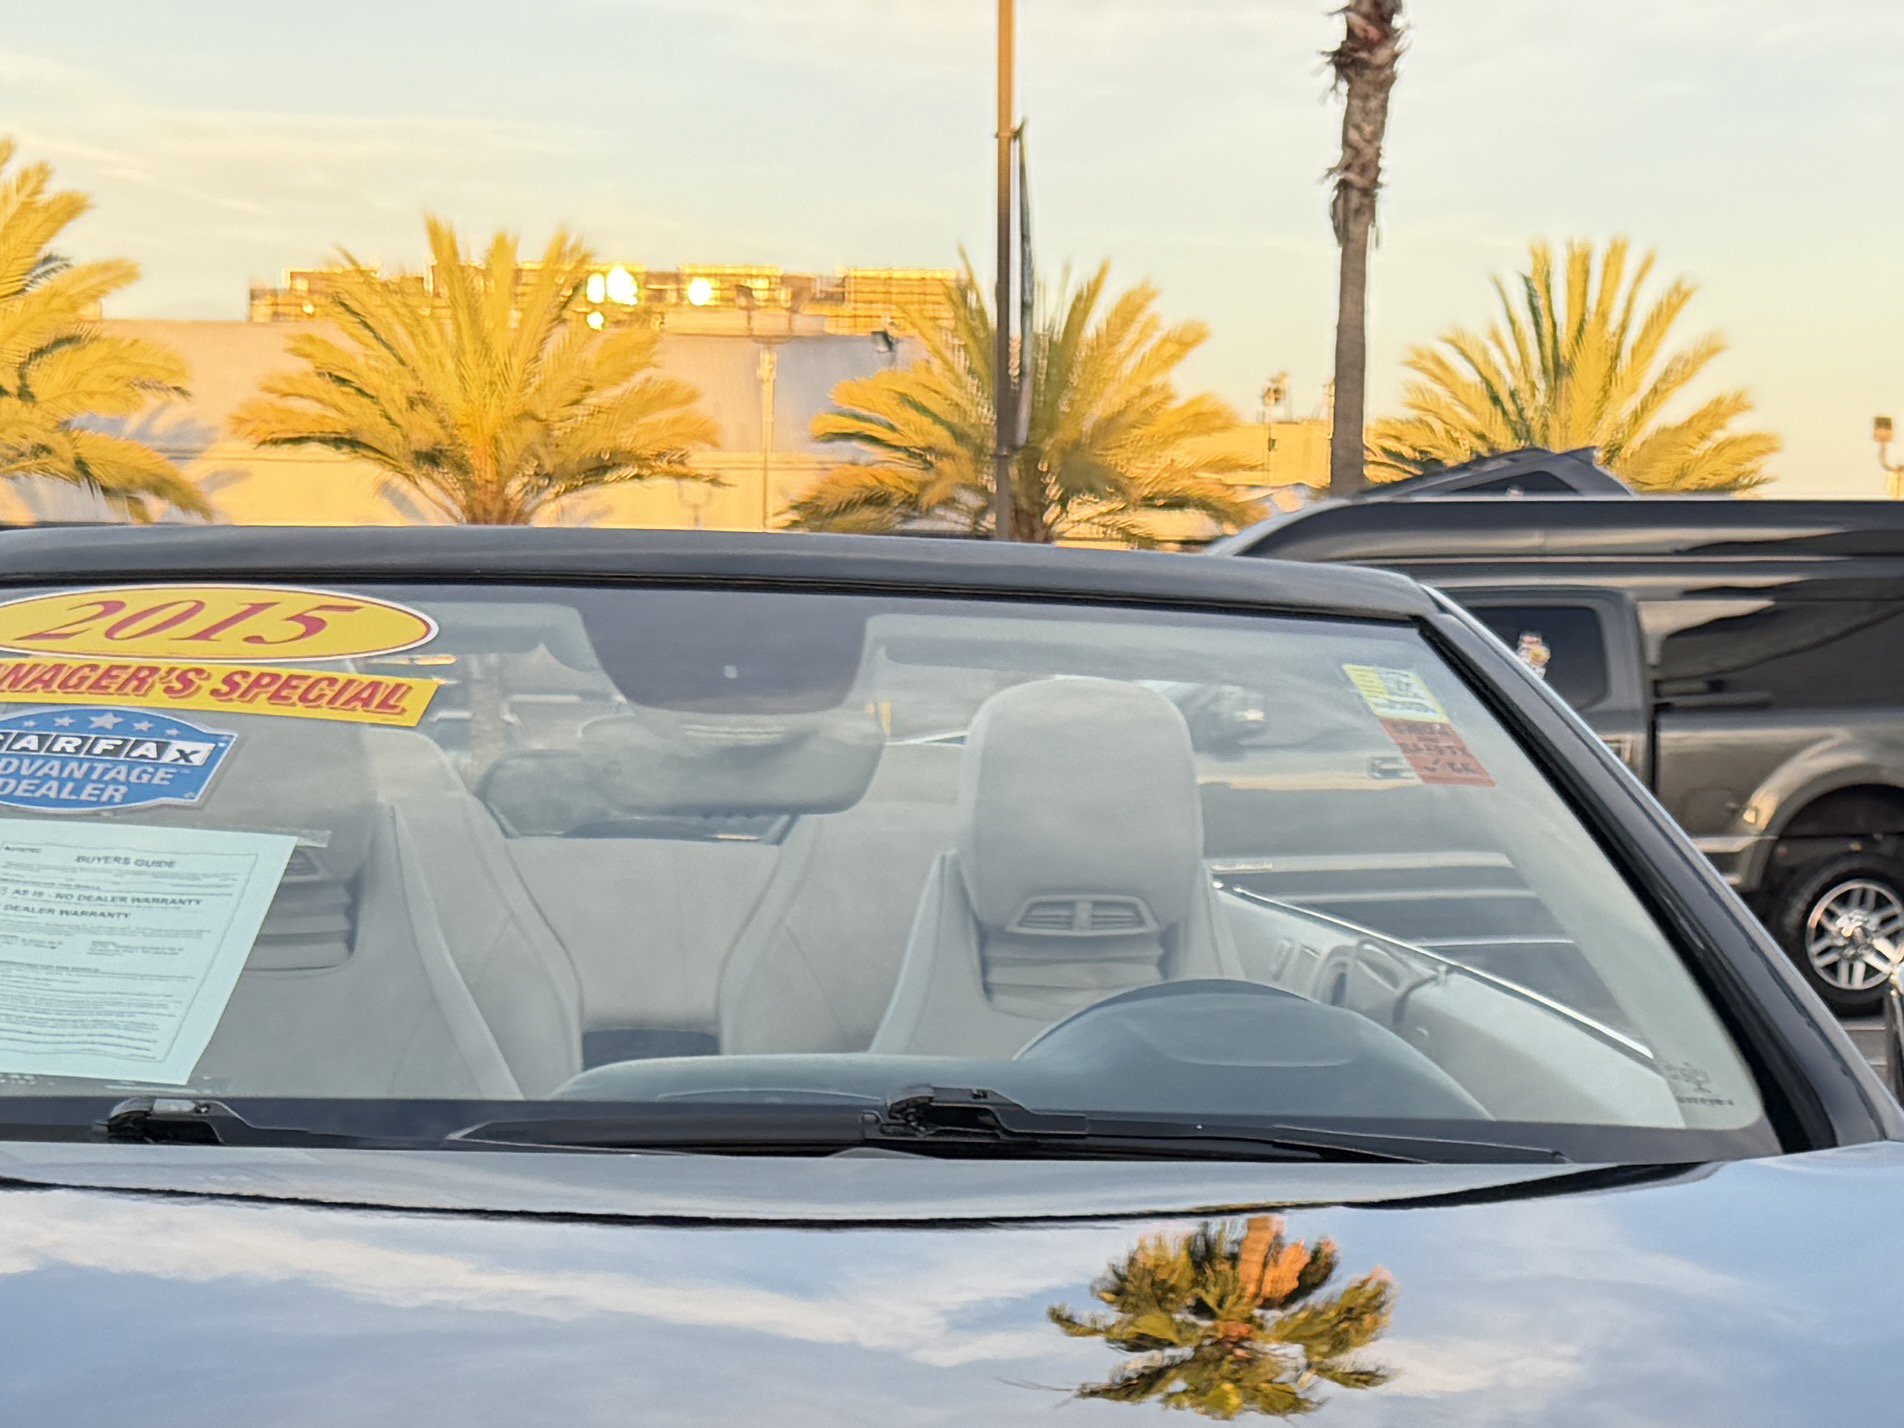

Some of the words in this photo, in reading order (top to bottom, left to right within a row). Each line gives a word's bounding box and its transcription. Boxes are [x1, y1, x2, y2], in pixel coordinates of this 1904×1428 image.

[14, 599, 364, 645] 2015
[209, 669, 413, 714] SPECIAL
[75, 854, 131, 866] BUYERS
[134, 858, 176, 868] GUIDE
